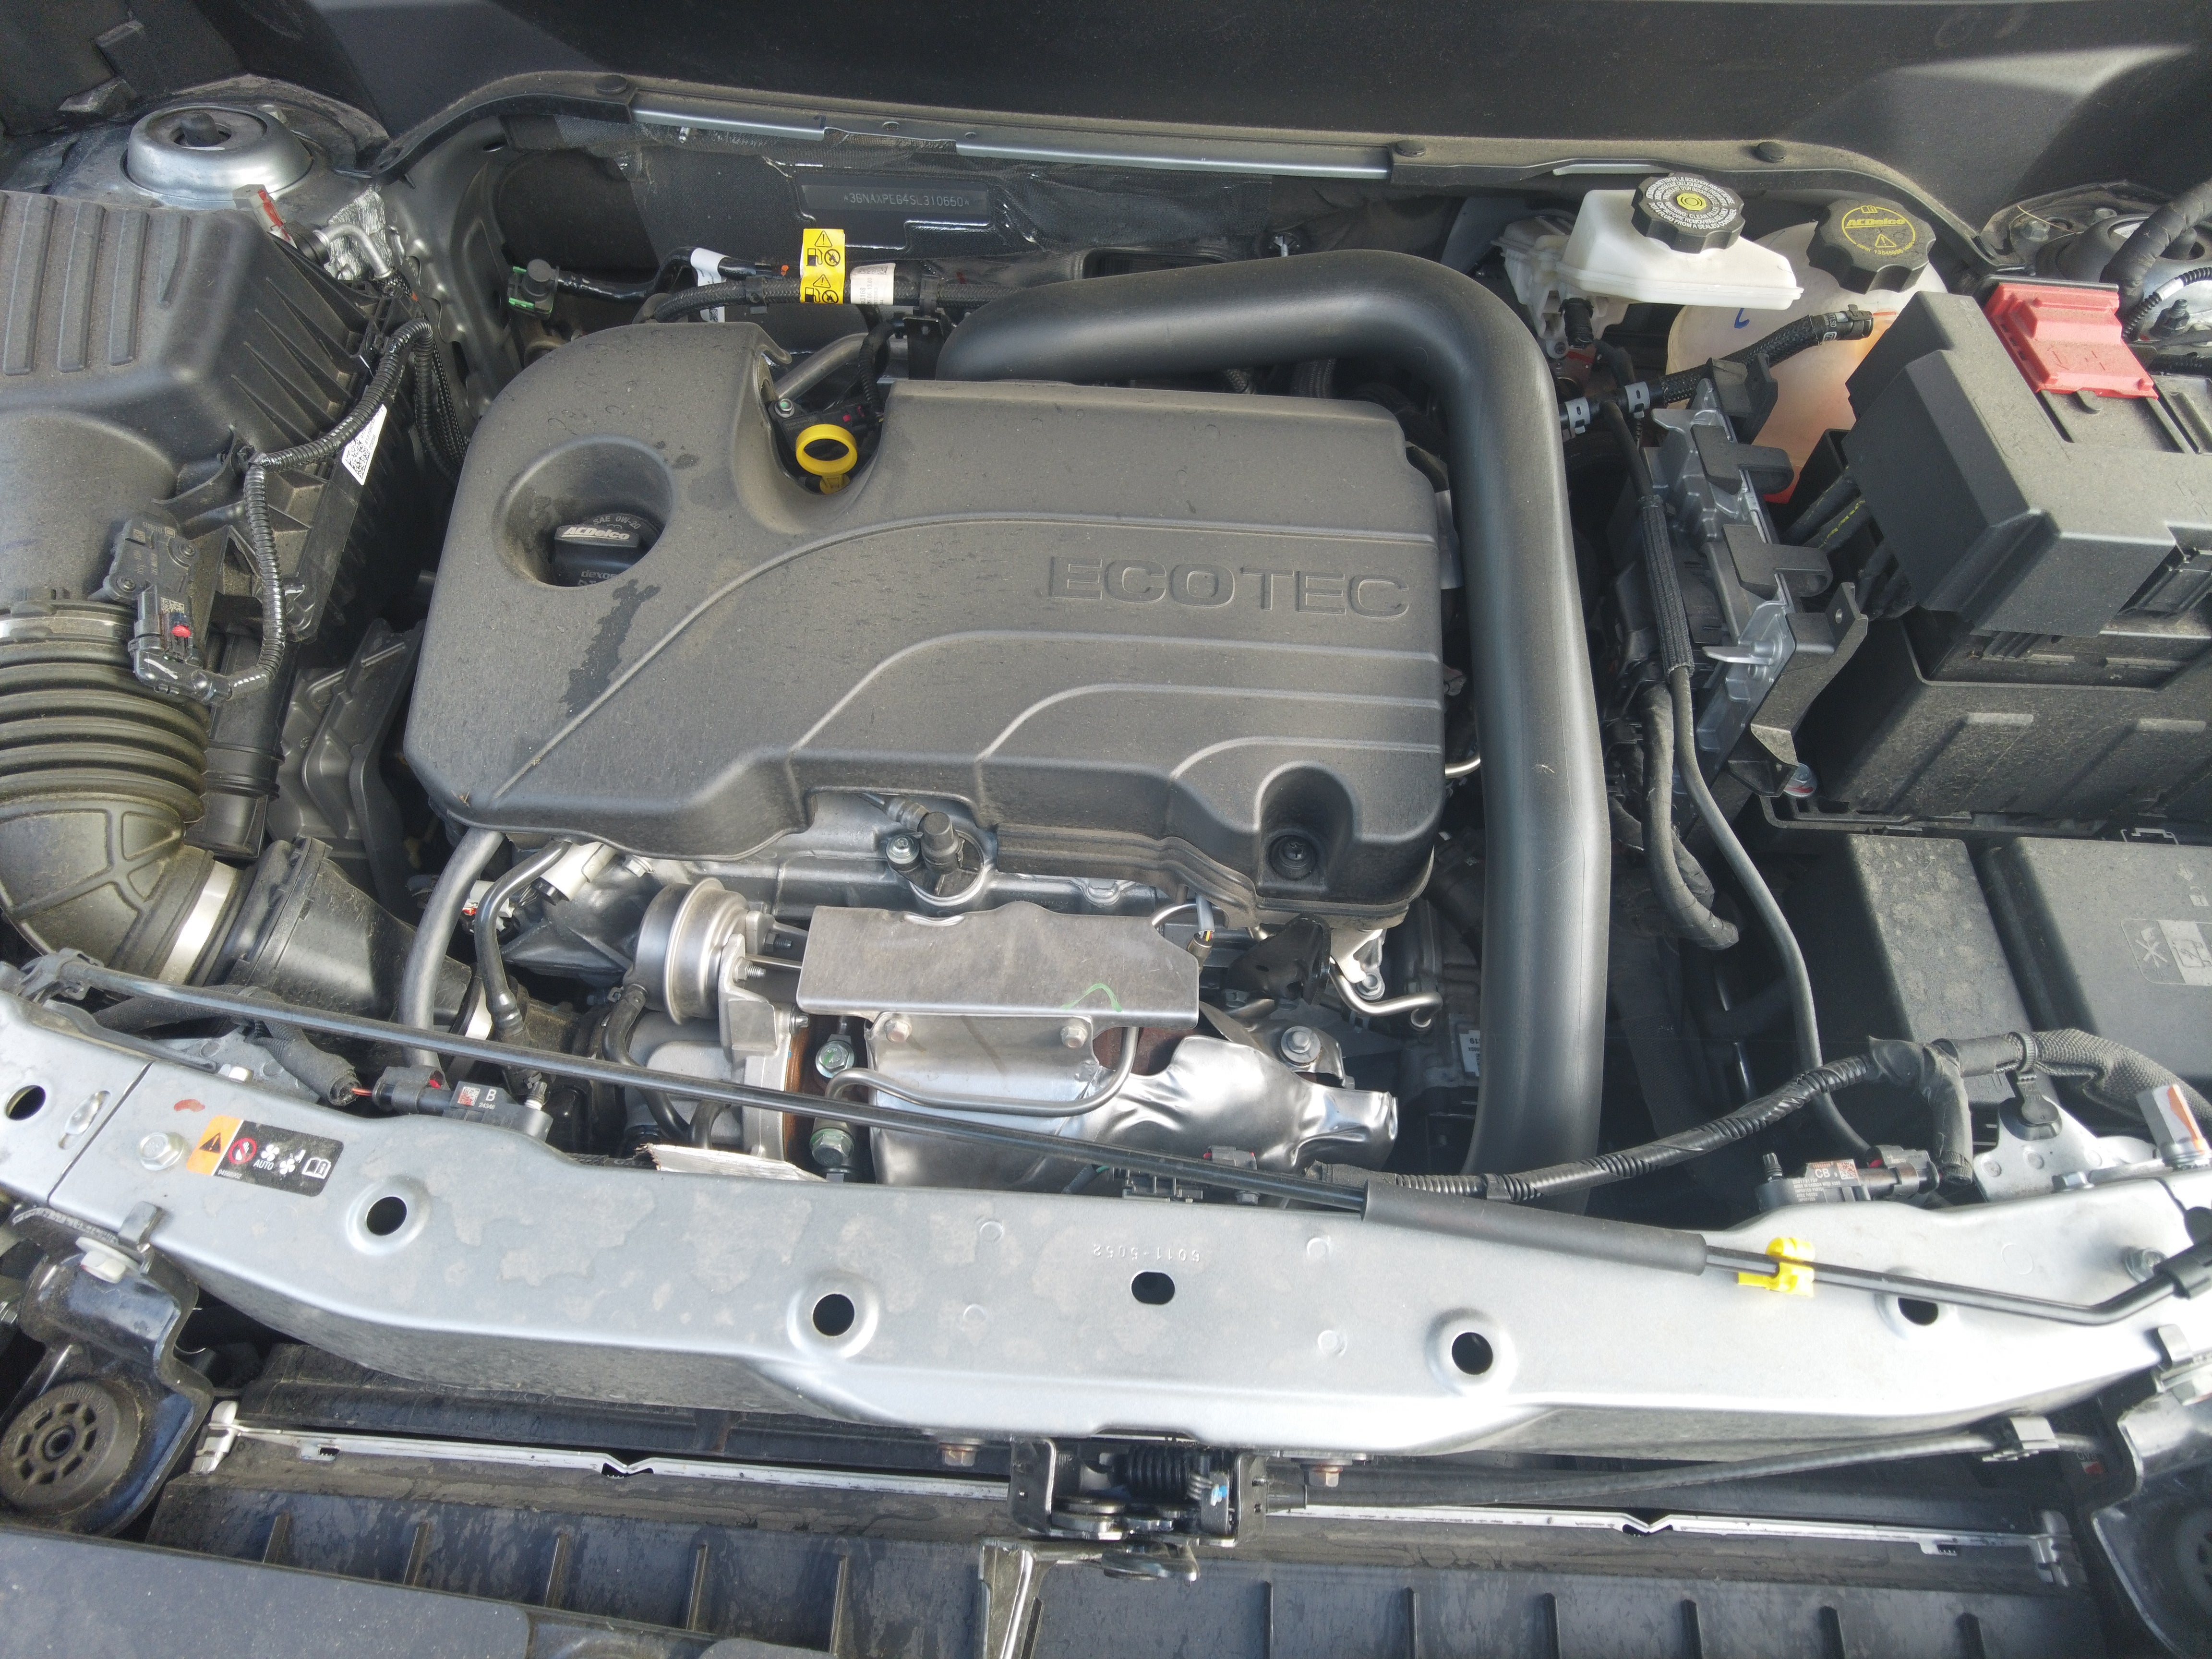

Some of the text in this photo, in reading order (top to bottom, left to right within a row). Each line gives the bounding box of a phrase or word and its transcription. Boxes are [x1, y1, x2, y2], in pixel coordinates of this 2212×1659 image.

[1673, 219, 1692, 228] FROM
[1847, 218, 1906, 226] ACDelco
[593, 516, 642, 530] SAE 0W-20
[563, 527, 630, 541] ACDelco
[1048, 556, 1410, 620] ECOTEC
[485, 1088, 497, 1102] B
[252, 1159, 274, 1171] AUTO
[1815, 1168, 1831, 1178] CB
